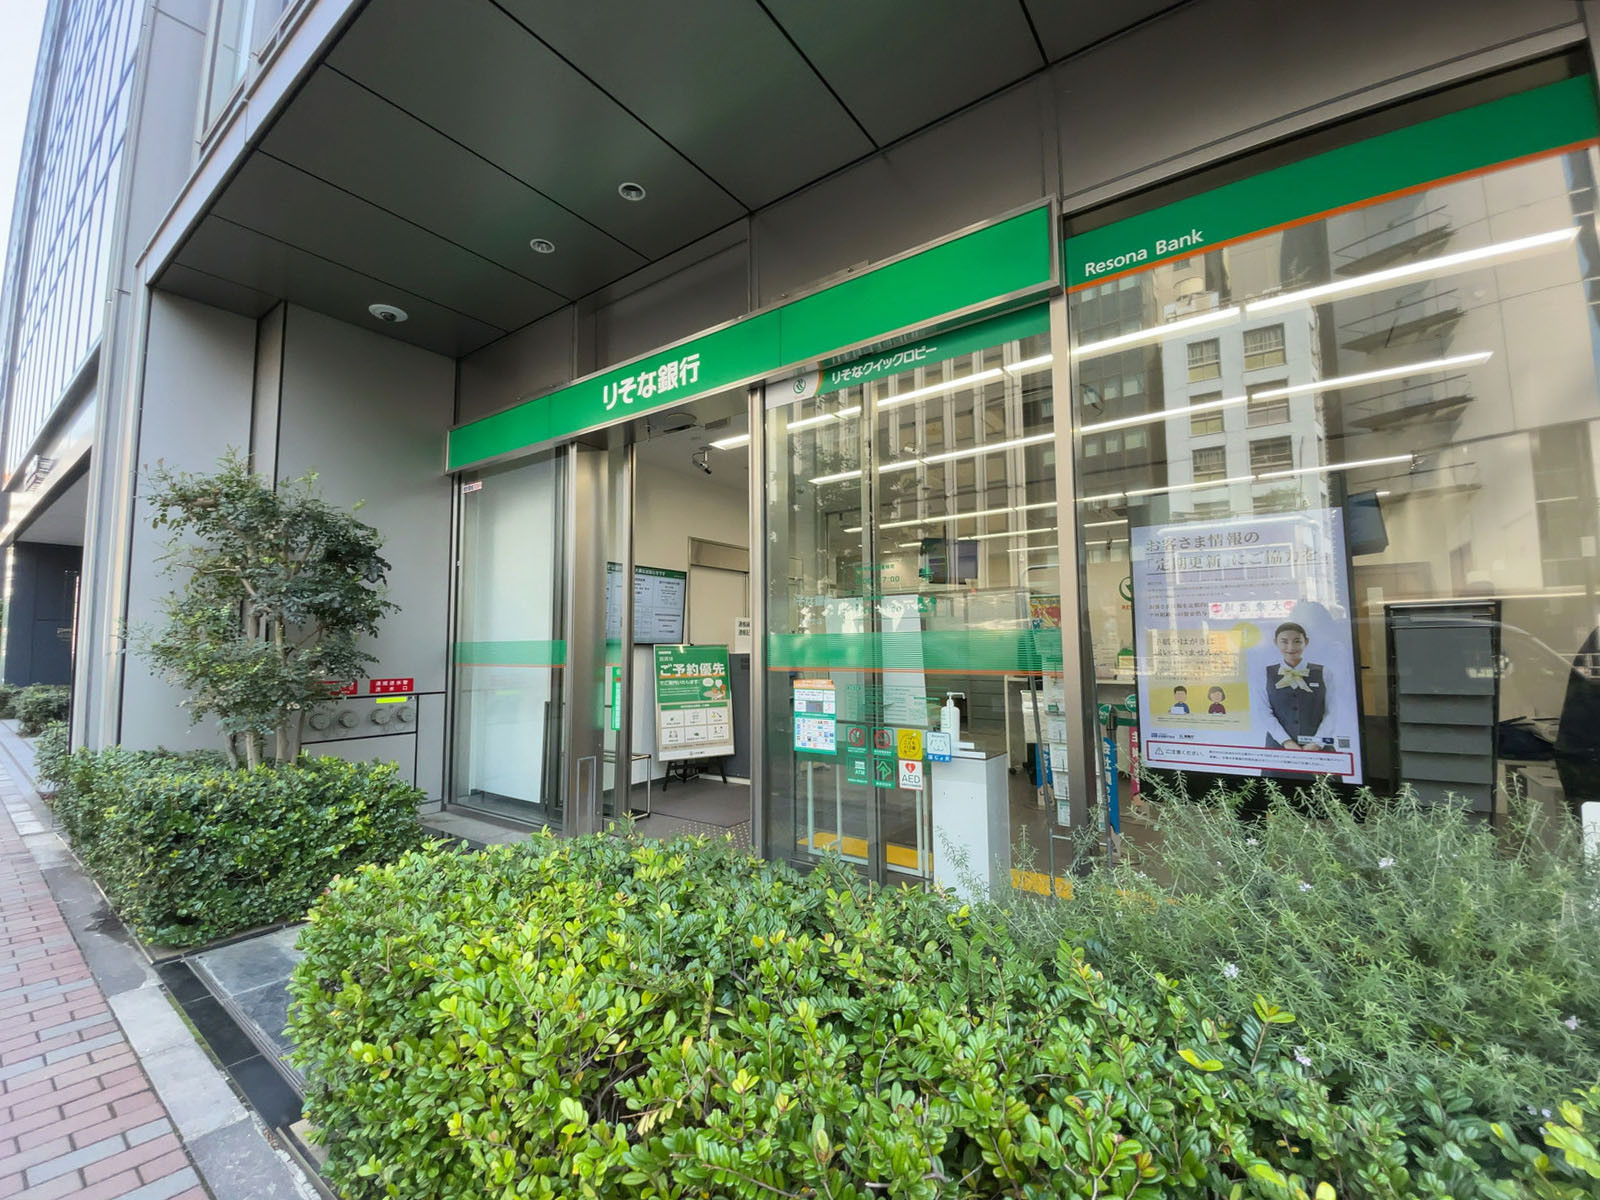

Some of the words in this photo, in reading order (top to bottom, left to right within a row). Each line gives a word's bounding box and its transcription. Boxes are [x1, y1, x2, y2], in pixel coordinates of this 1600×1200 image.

[1085, 248, 1148, 277] Resona
[1155, 229, 1203, 255] Bank
[603, 353, 700, 411] りそな銀行
[832, 346, 937, 385] りそなクイックロビー
[659, 662, 726, 677] ご予約優先
[901, 773, 921, 784] AED
